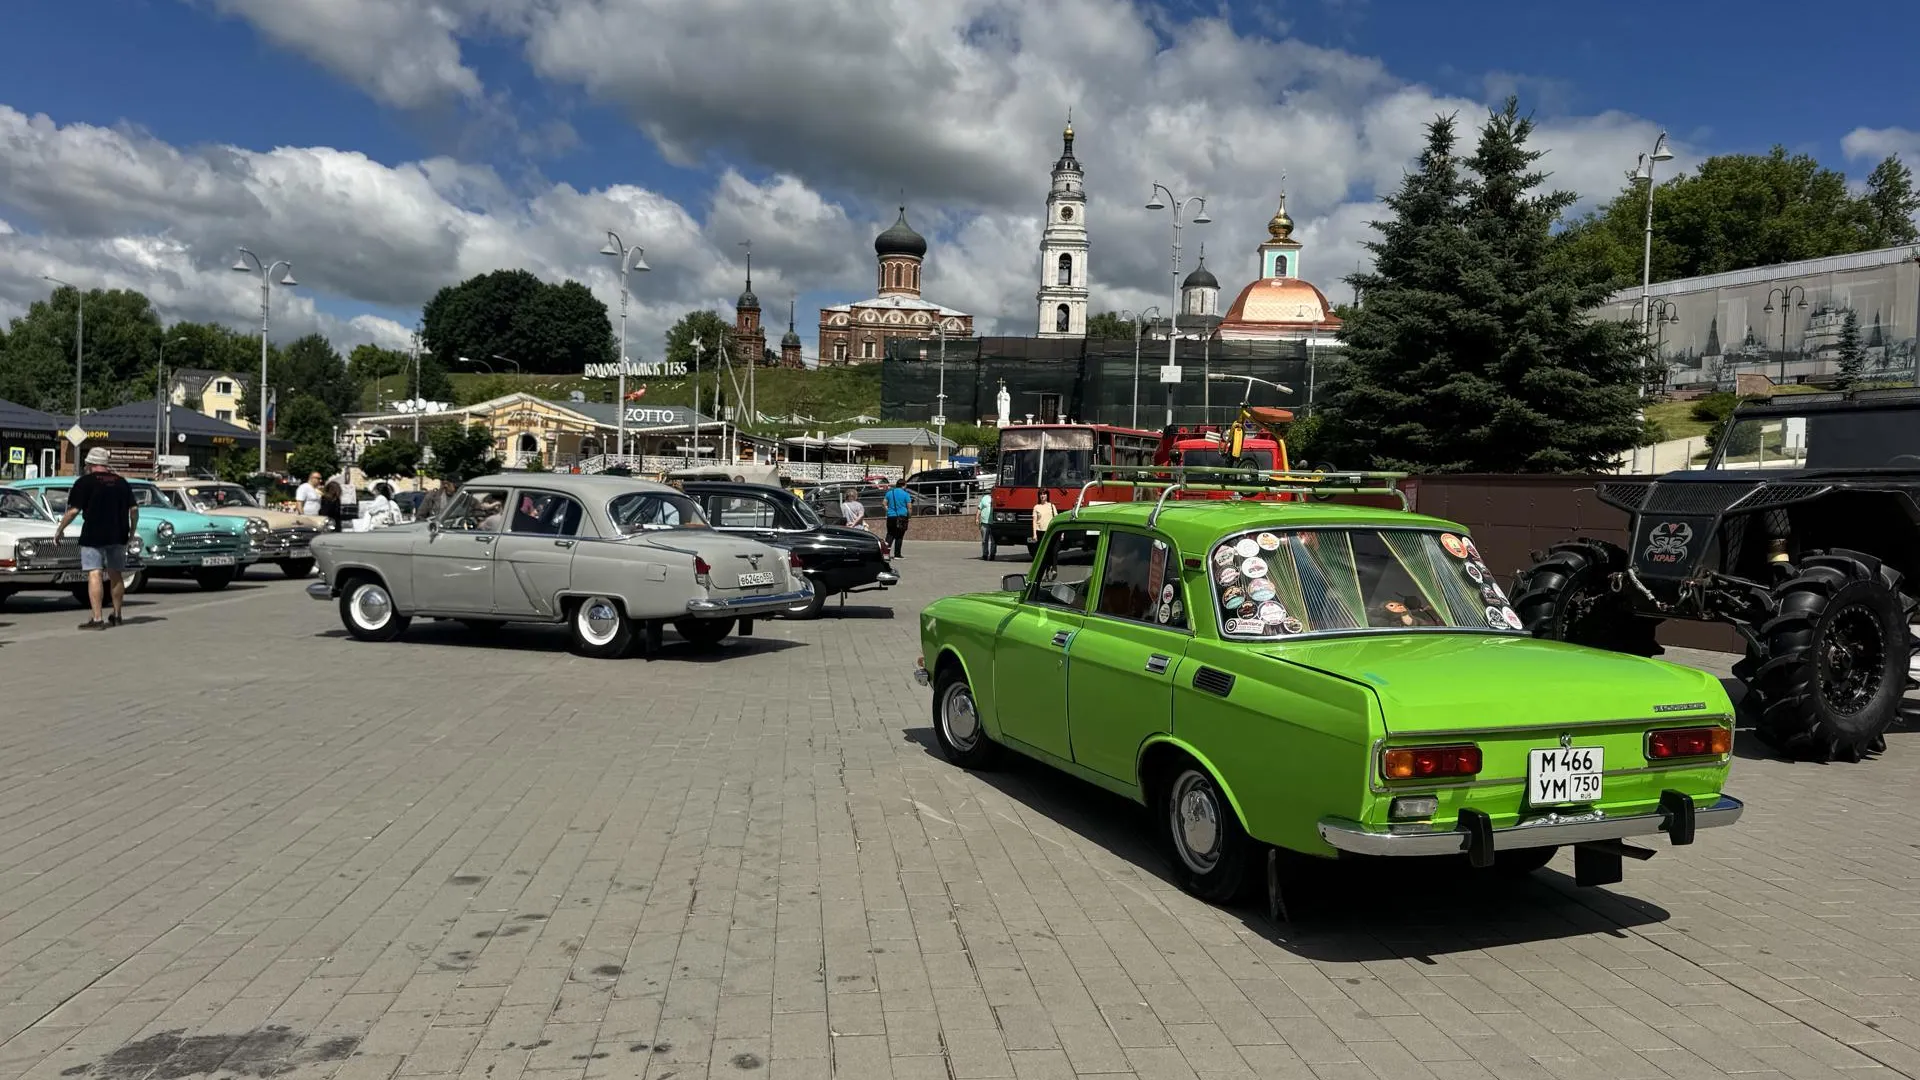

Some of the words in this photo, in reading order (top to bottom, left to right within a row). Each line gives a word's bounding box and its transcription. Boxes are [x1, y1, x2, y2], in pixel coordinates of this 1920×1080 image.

[664, 361, 688, 376] 1135
[625, 408, 674, 423] ZOTTO
[1540, 778, 1567, 800] УМ
[1574, 776, 1600, 792] 750
